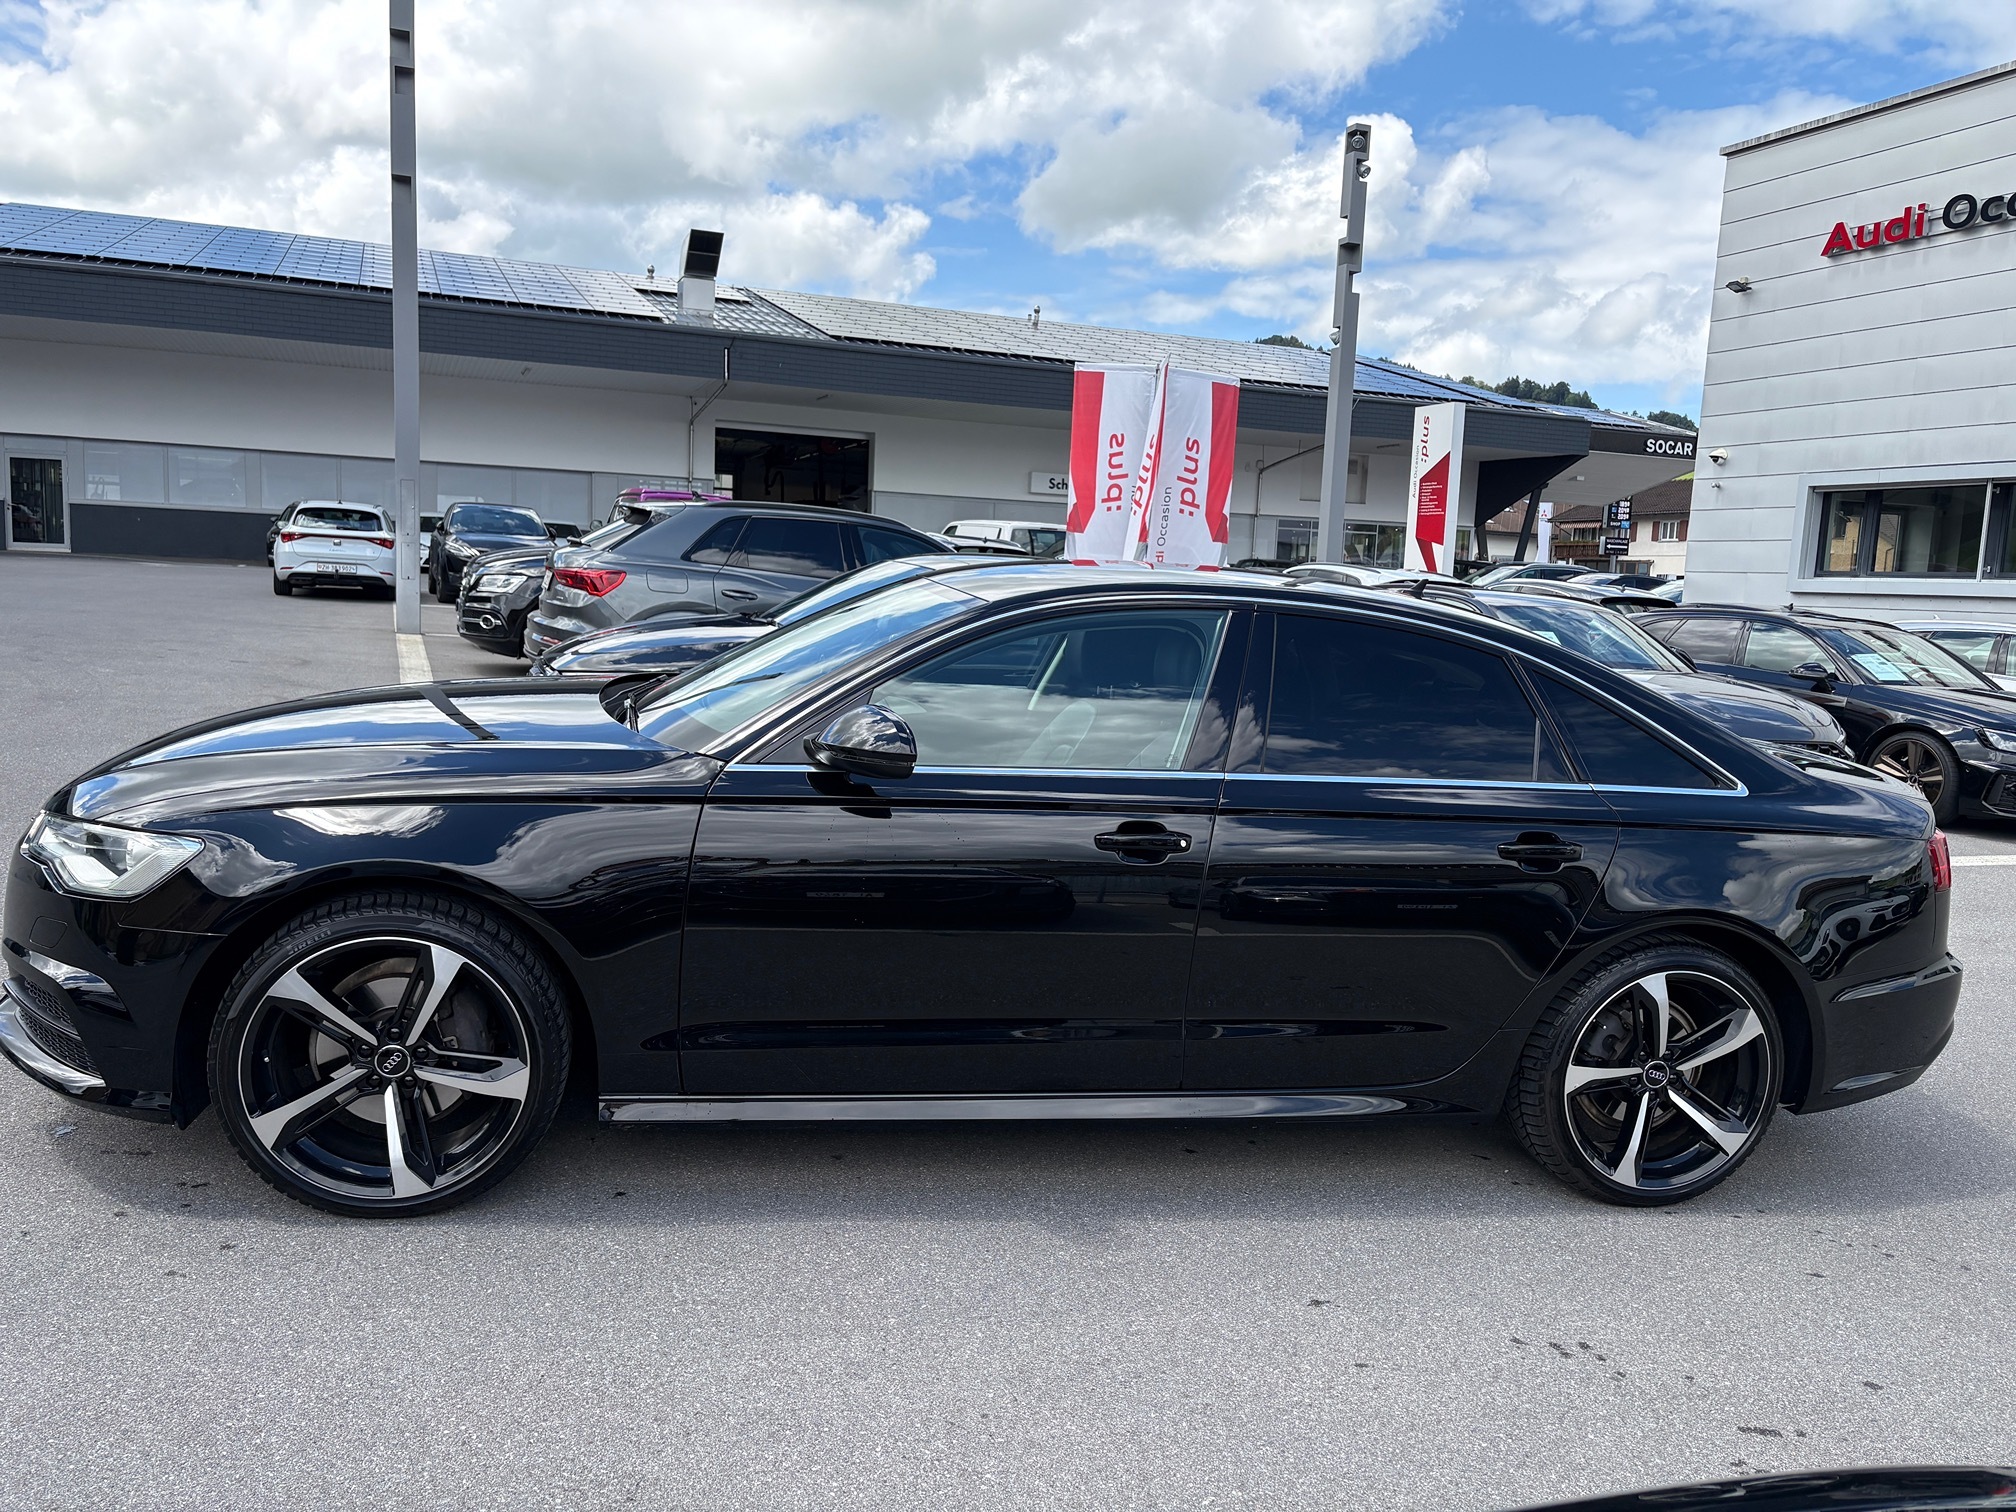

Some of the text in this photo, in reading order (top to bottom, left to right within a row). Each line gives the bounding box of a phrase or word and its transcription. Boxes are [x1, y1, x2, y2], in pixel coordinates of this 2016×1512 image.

[1820, 202, 1928, 257] Audi
[1420, 415, 1430, 463] :plus
[1645, 438, 1694, 456] SOCAR
[1176, 436, 1201, 518] :plus
[1156, 486, 1173, 547] Occasion
